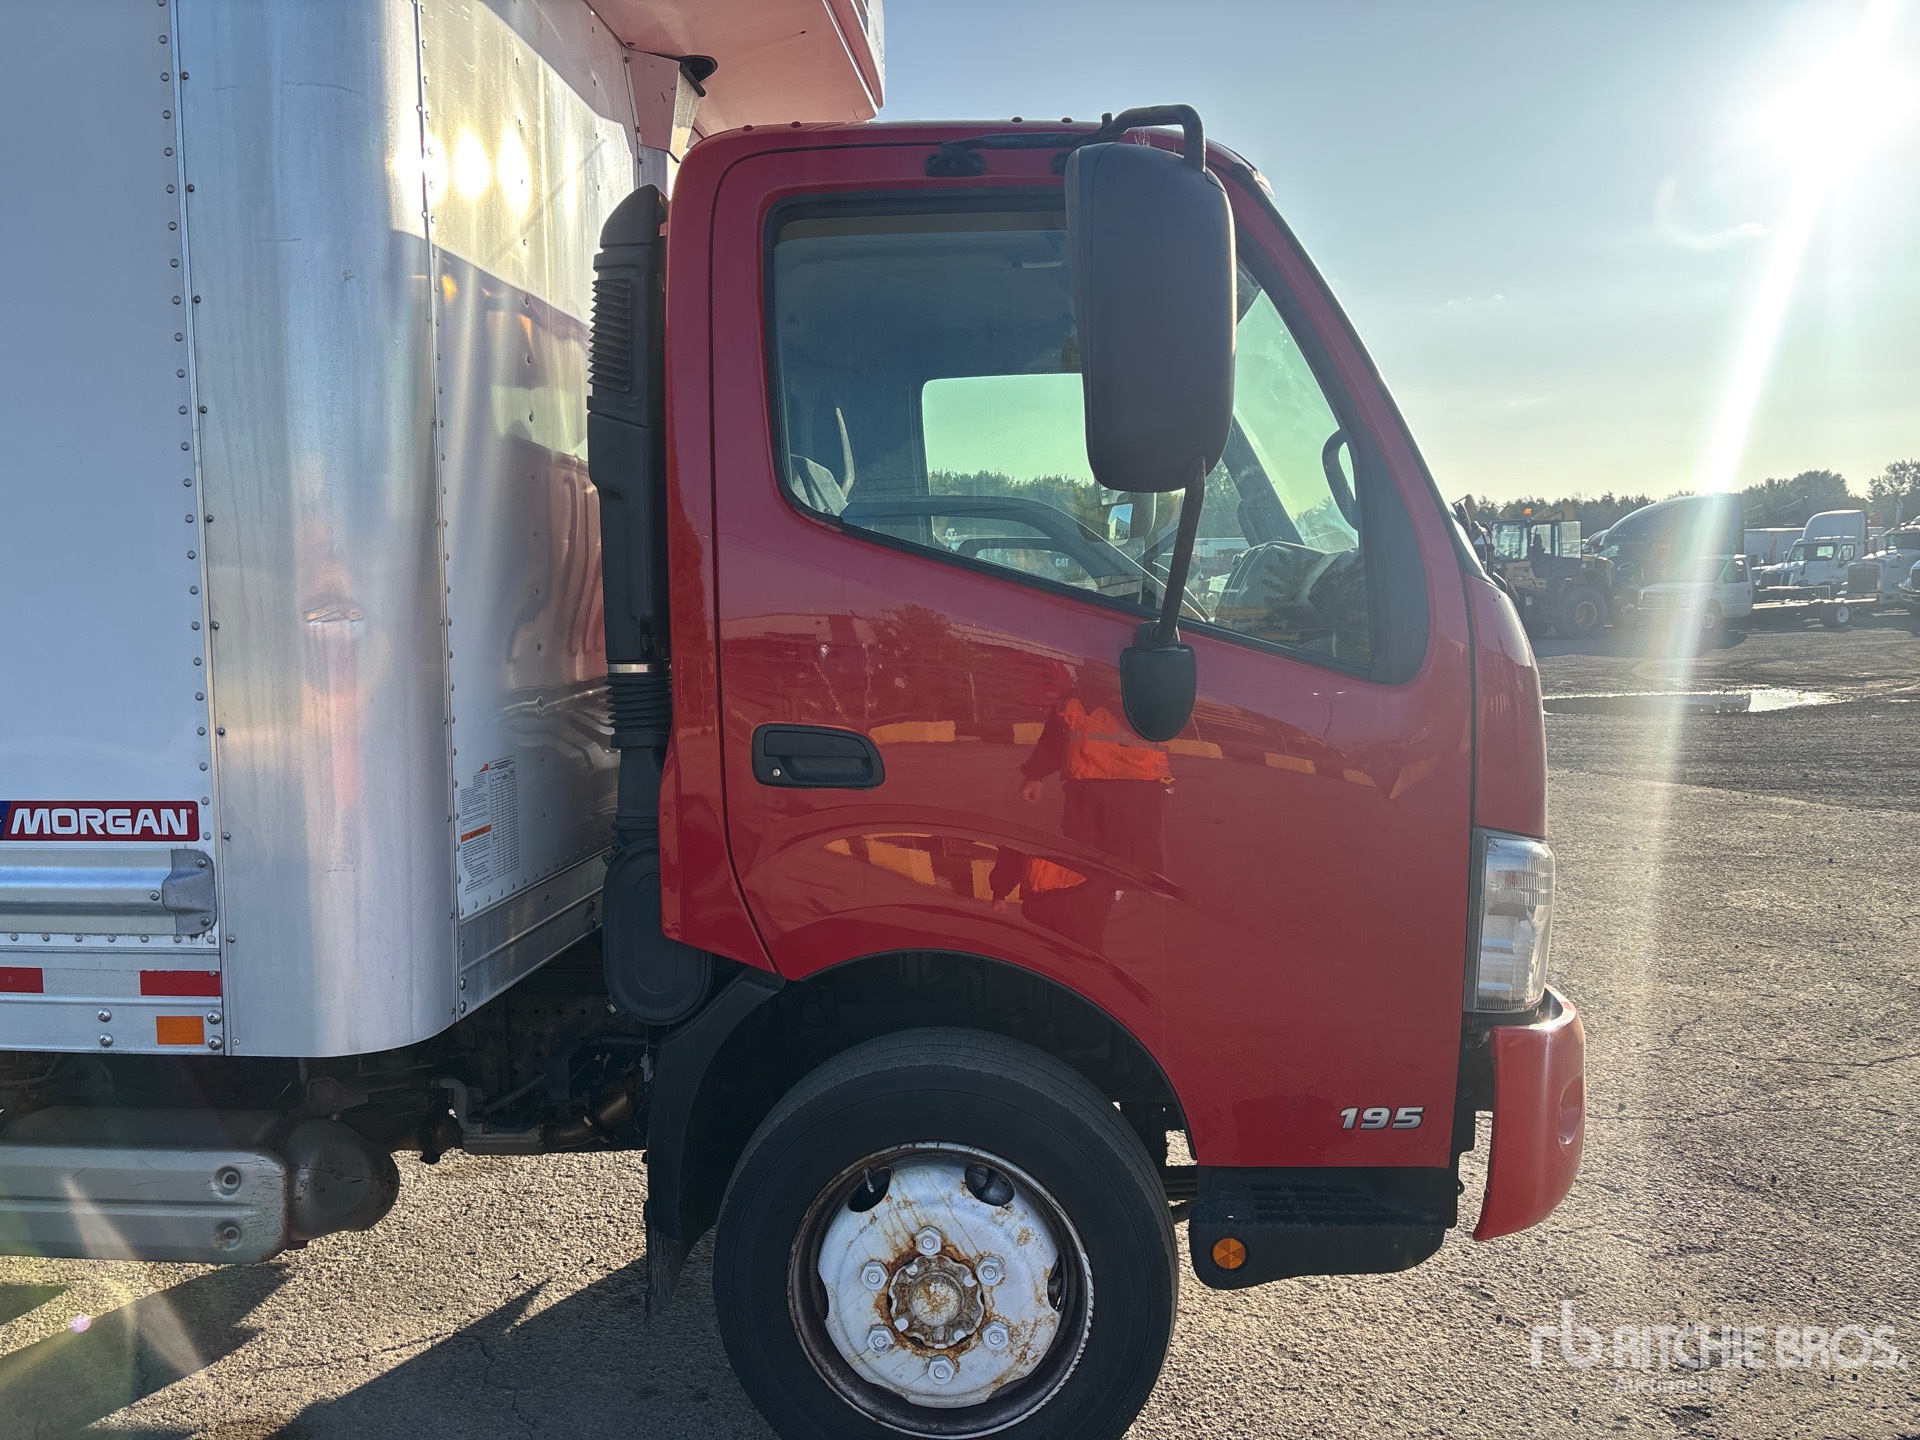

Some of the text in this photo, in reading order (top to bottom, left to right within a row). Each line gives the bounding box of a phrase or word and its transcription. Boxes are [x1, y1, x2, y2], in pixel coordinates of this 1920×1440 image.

[1055, 557, 1070, 567] CAT
[10, 807, 189, 836] MORGAN
[1340, 1106, 1424, 1130] 195
